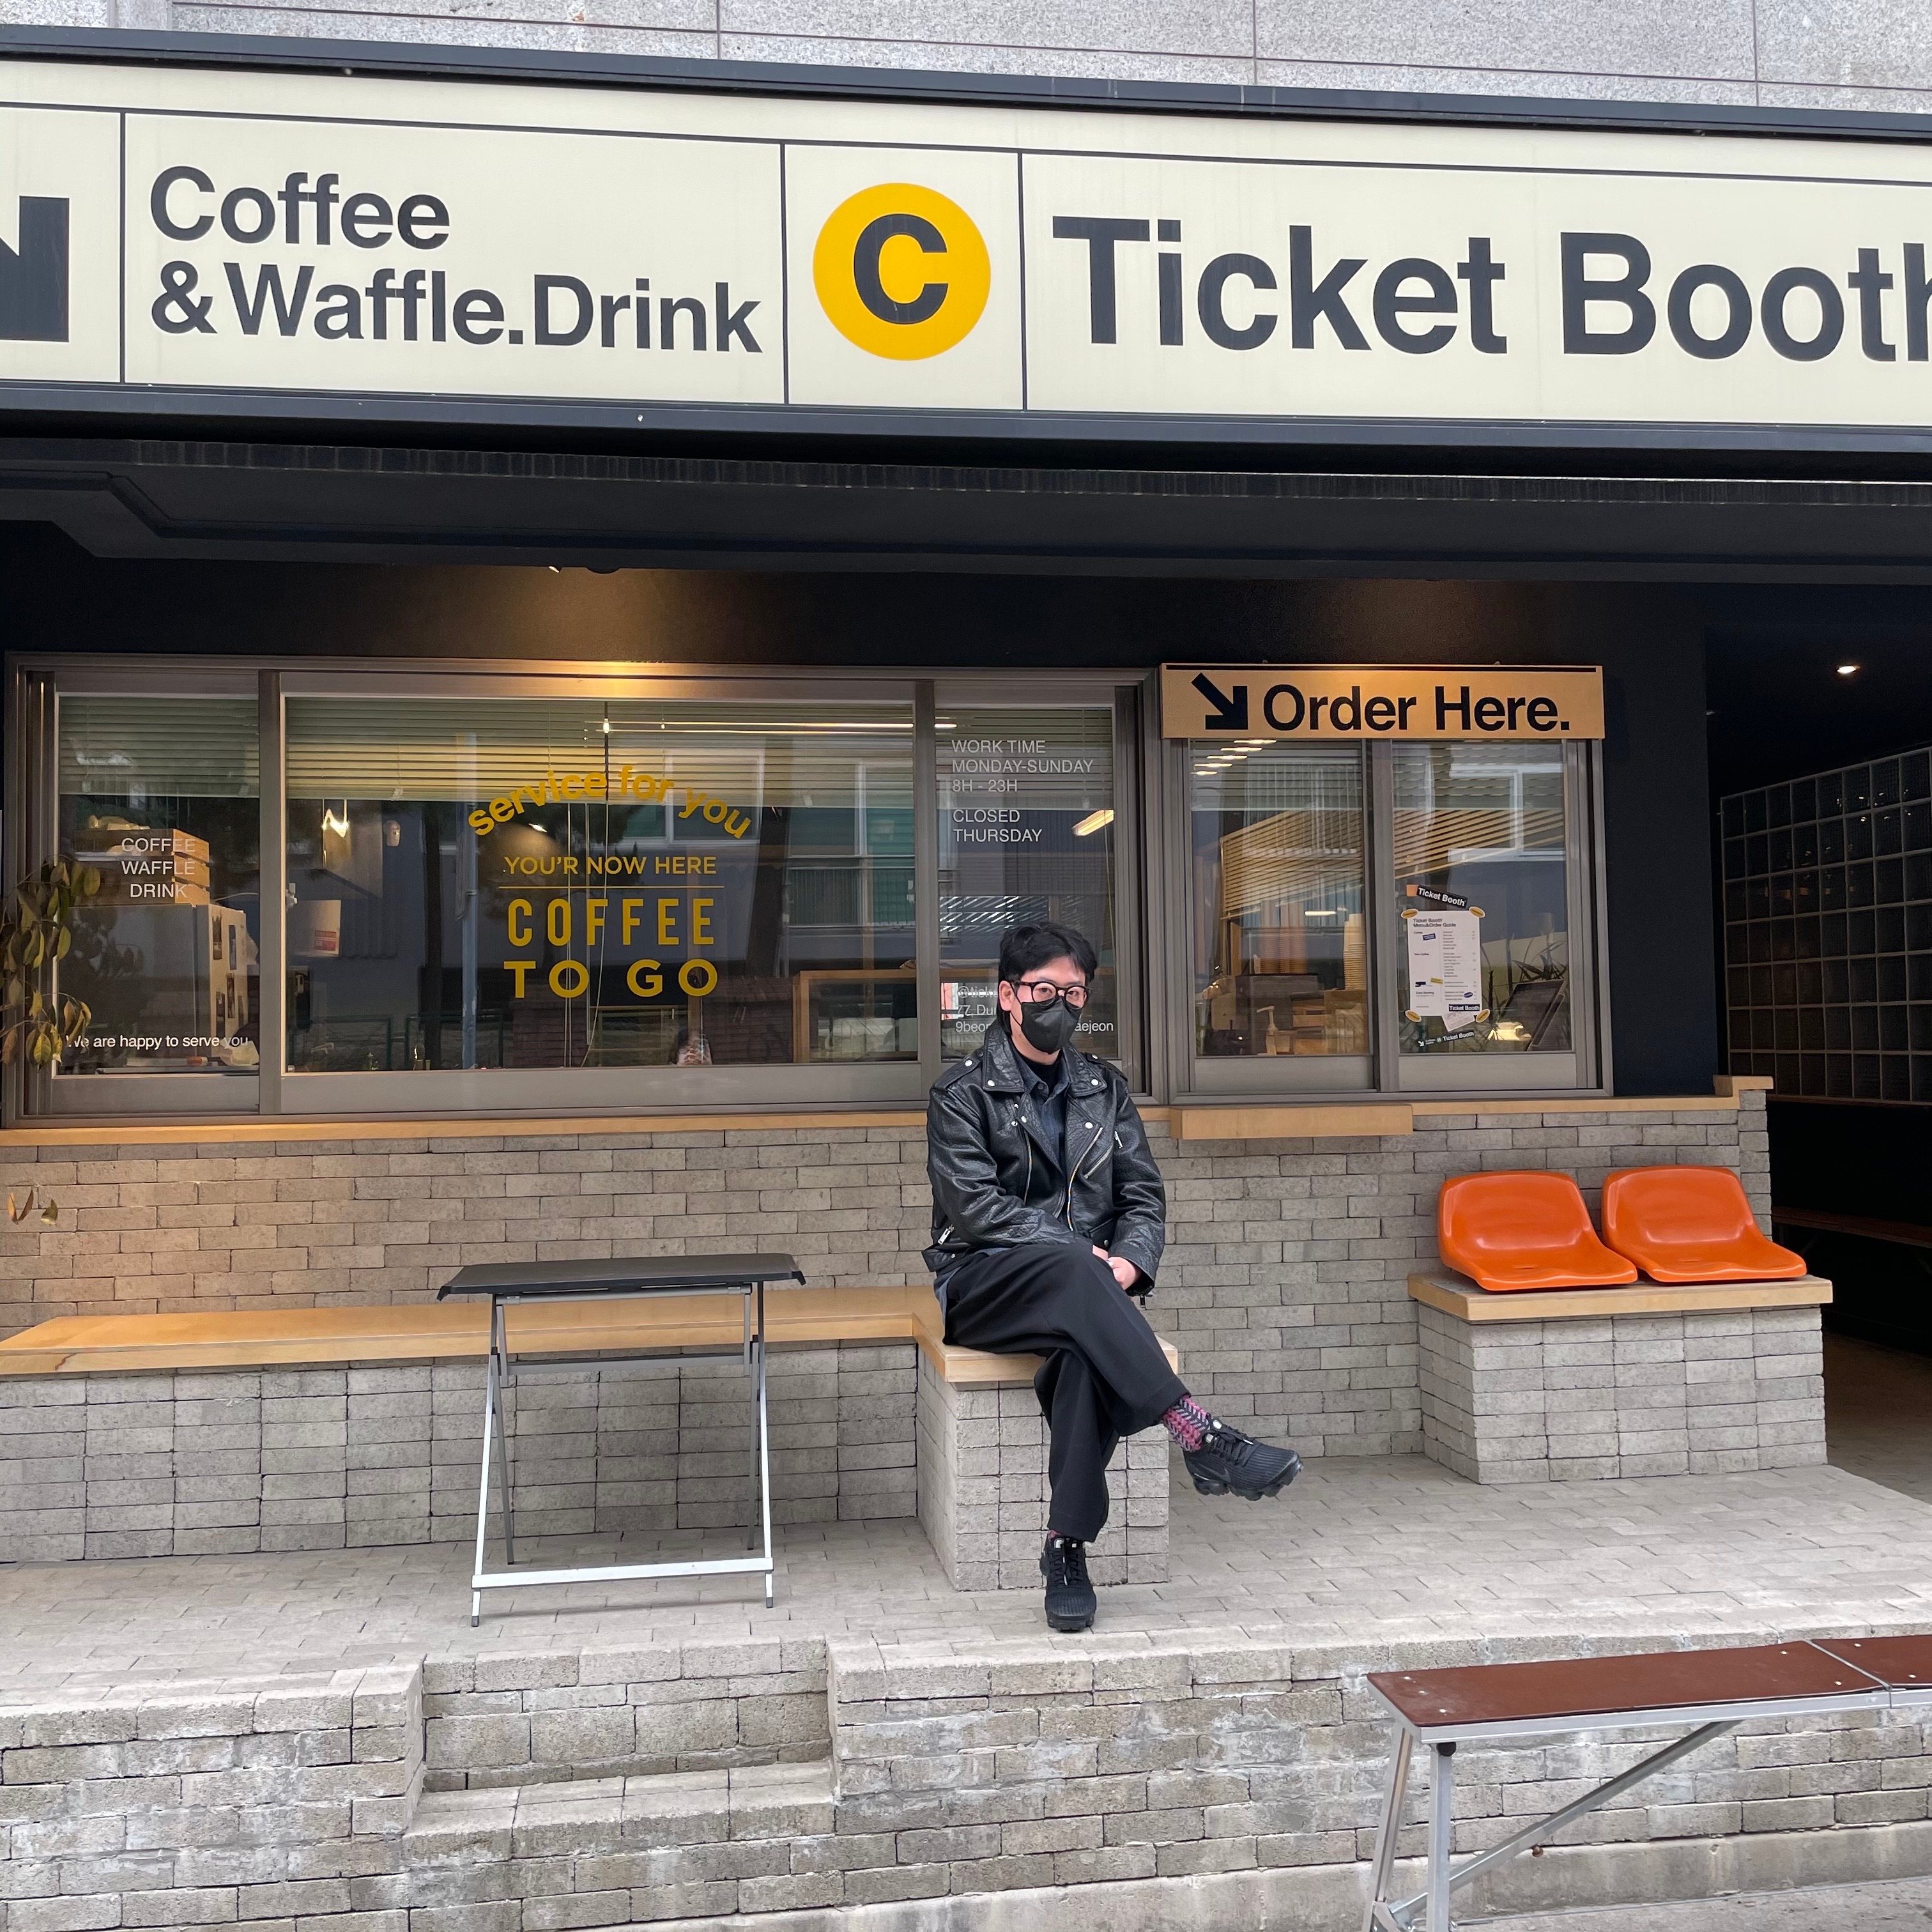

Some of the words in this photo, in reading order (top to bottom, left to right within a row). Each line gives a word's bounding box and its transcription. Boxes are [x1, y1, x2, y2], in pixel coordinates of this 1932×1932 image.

[150, 165, 450, 249] Coffee
[854, 213, 949, 325] C
[1052, 215, 1507, 354] Ticket
[1263, 684, 1416, 731] Order
[1434, 686, 1570, 731] Here.
[951, 739, 1003, 753] WORK
[1007, 740, 1046, 753] TIME
[952, 759, 1094, 773] MONDAY-SUNDAY
[952, 779, 973, 792] 8H
[988, 779, 1018, 792] 23H
[468, 770, 607, 836] service
[618, 765, 675, 803] for
[678, 786, 752, 839] you
[953, 809, 1020, 823] CLOSED
[953, 829, 1043, 843] THURSDAY
[121, 838, 195, 852] COFFEE
[121, 861, 195, 875] WAFFLE
[586, 857, 647, 875] NOW
[655, 857, 717, 875] HERE
[130, 884, 187, 898] DRINK
[1418, 887, 1441, 900] Ticket
[1442, 894, 1466, 907] Booth
[508, 898, 714, 947] COFFEE
[503, 959, 590, 999] TO
[626, 958, 718, 997] GO
[1075, 1020, 1114, 1034] aejeon
[66, 1035, 89, 1048] We
[93, 1038, 116, 1047] are
[119, 1035, 162, 1050] happy
[165, 1036, 179, 1047] to
[182, 1037, 220, 1047] serve
[224, 1036, 248, 1048] you
